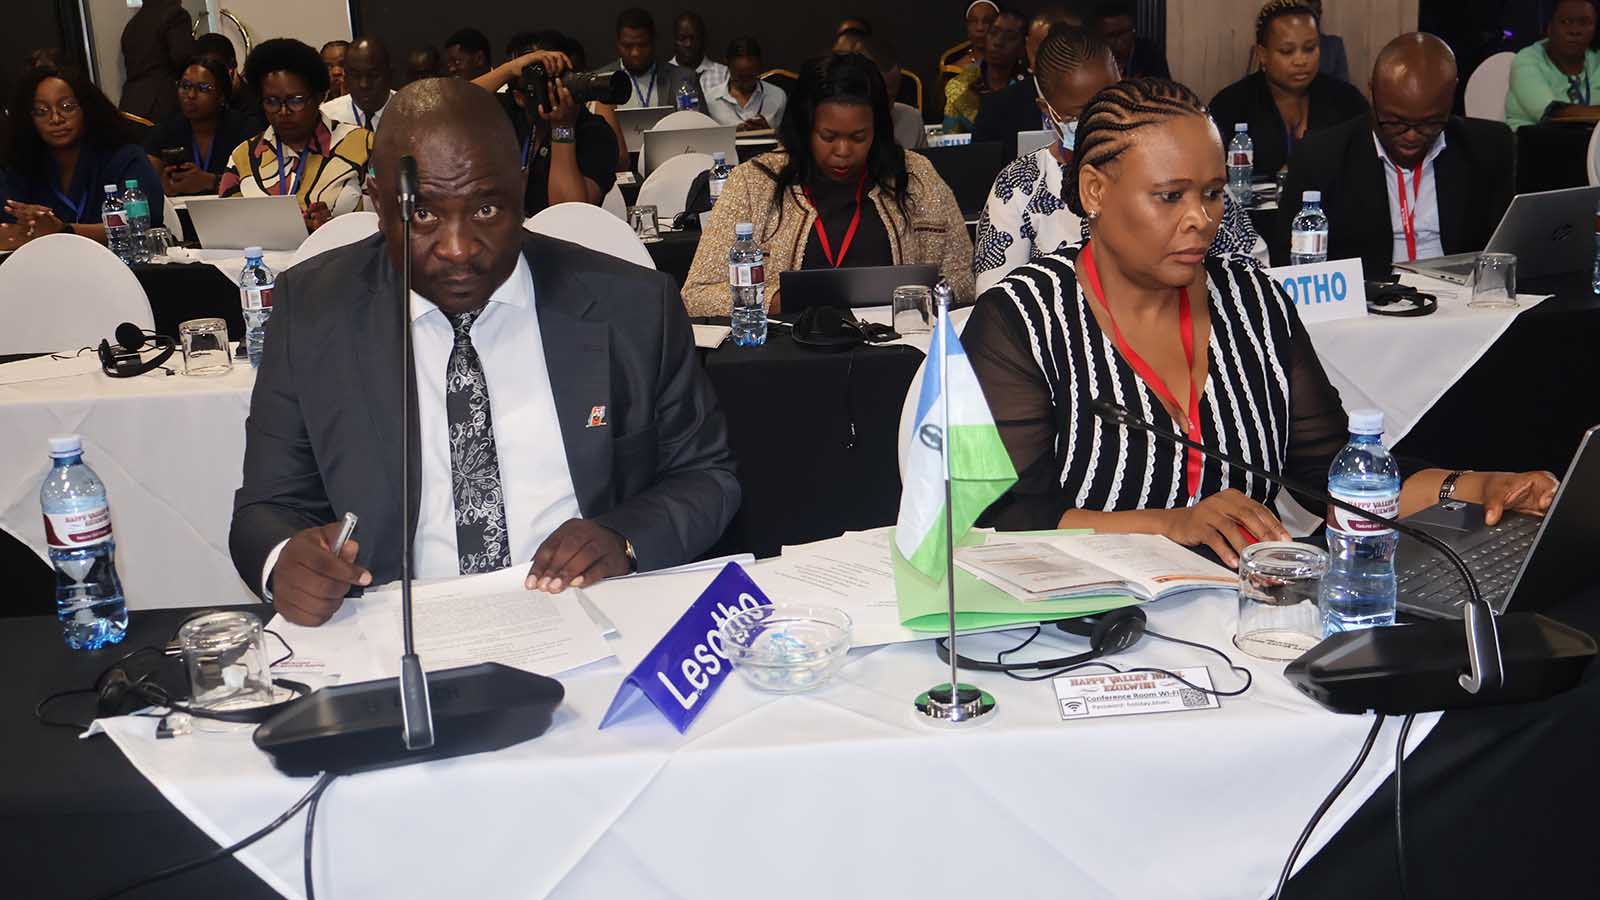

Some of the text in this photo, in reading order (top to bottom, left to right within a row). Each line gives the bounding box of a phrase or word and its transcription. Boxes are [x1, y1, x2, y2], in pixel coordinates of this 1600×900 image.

[656, 592, 766, 710] Lesotho
[1071, 676, 1105, 687] HAPPY
[1108, 673, 1148, 684] VALLEY
[1086, 694, 1132, 703] Conference
[1133, 691, 1157, 699] Room
